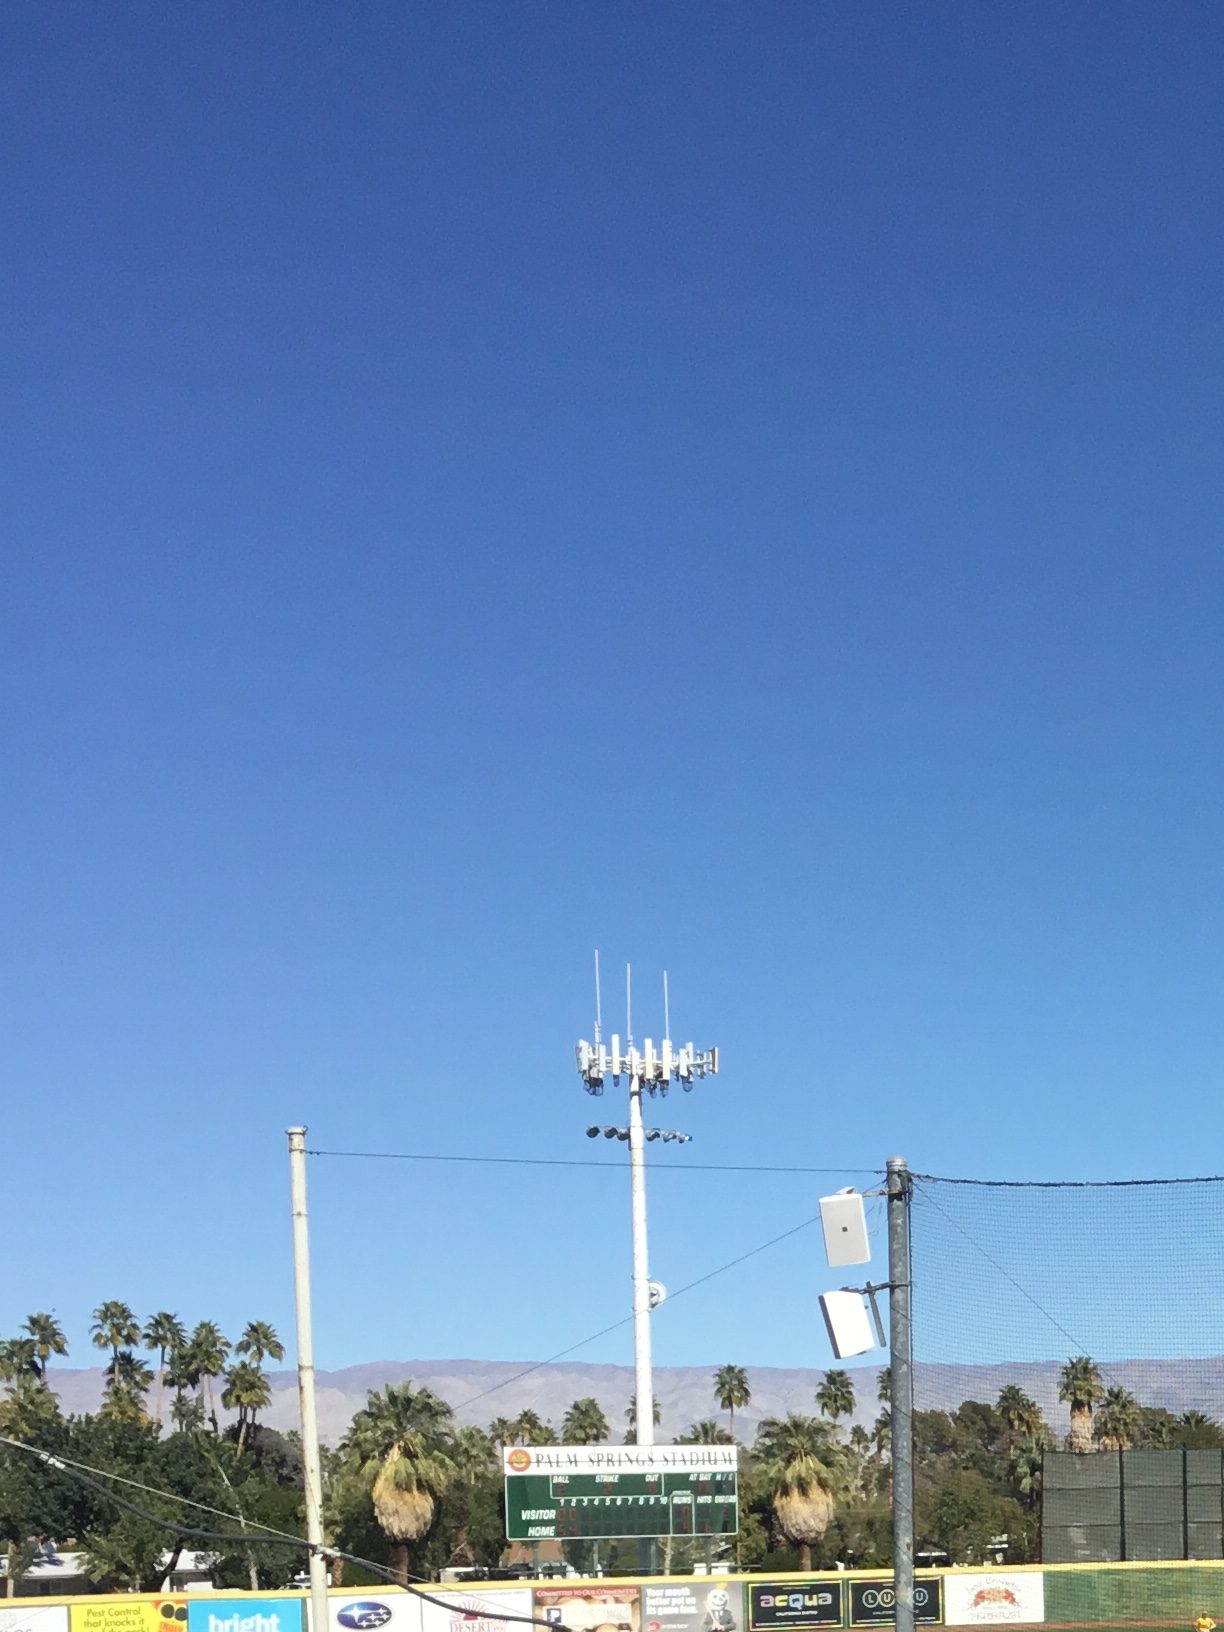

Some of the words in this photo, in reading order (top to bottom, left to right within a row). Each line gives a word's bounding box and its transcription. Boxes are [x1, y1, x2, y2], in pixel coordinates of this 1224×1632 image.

[535, 1453, 578, 1467] PALM
[587, 1452, 655, 1467] SPRINGS
[662, 1451, 733, 1466] STADIUM
[553, 1475, 569, 1483] BALL
[645, 1474, 659, 1482] OUT
[521, 1510, 556, 1521] VISITOR
[528, 1527, 555, 1536] HOME
[87, 1608, 104, 1617] Pest
[108, 1606, 141, 1617] Control
[84, 1619, 102, 1627] that
[104, 1618, 136, 1627] knocks
